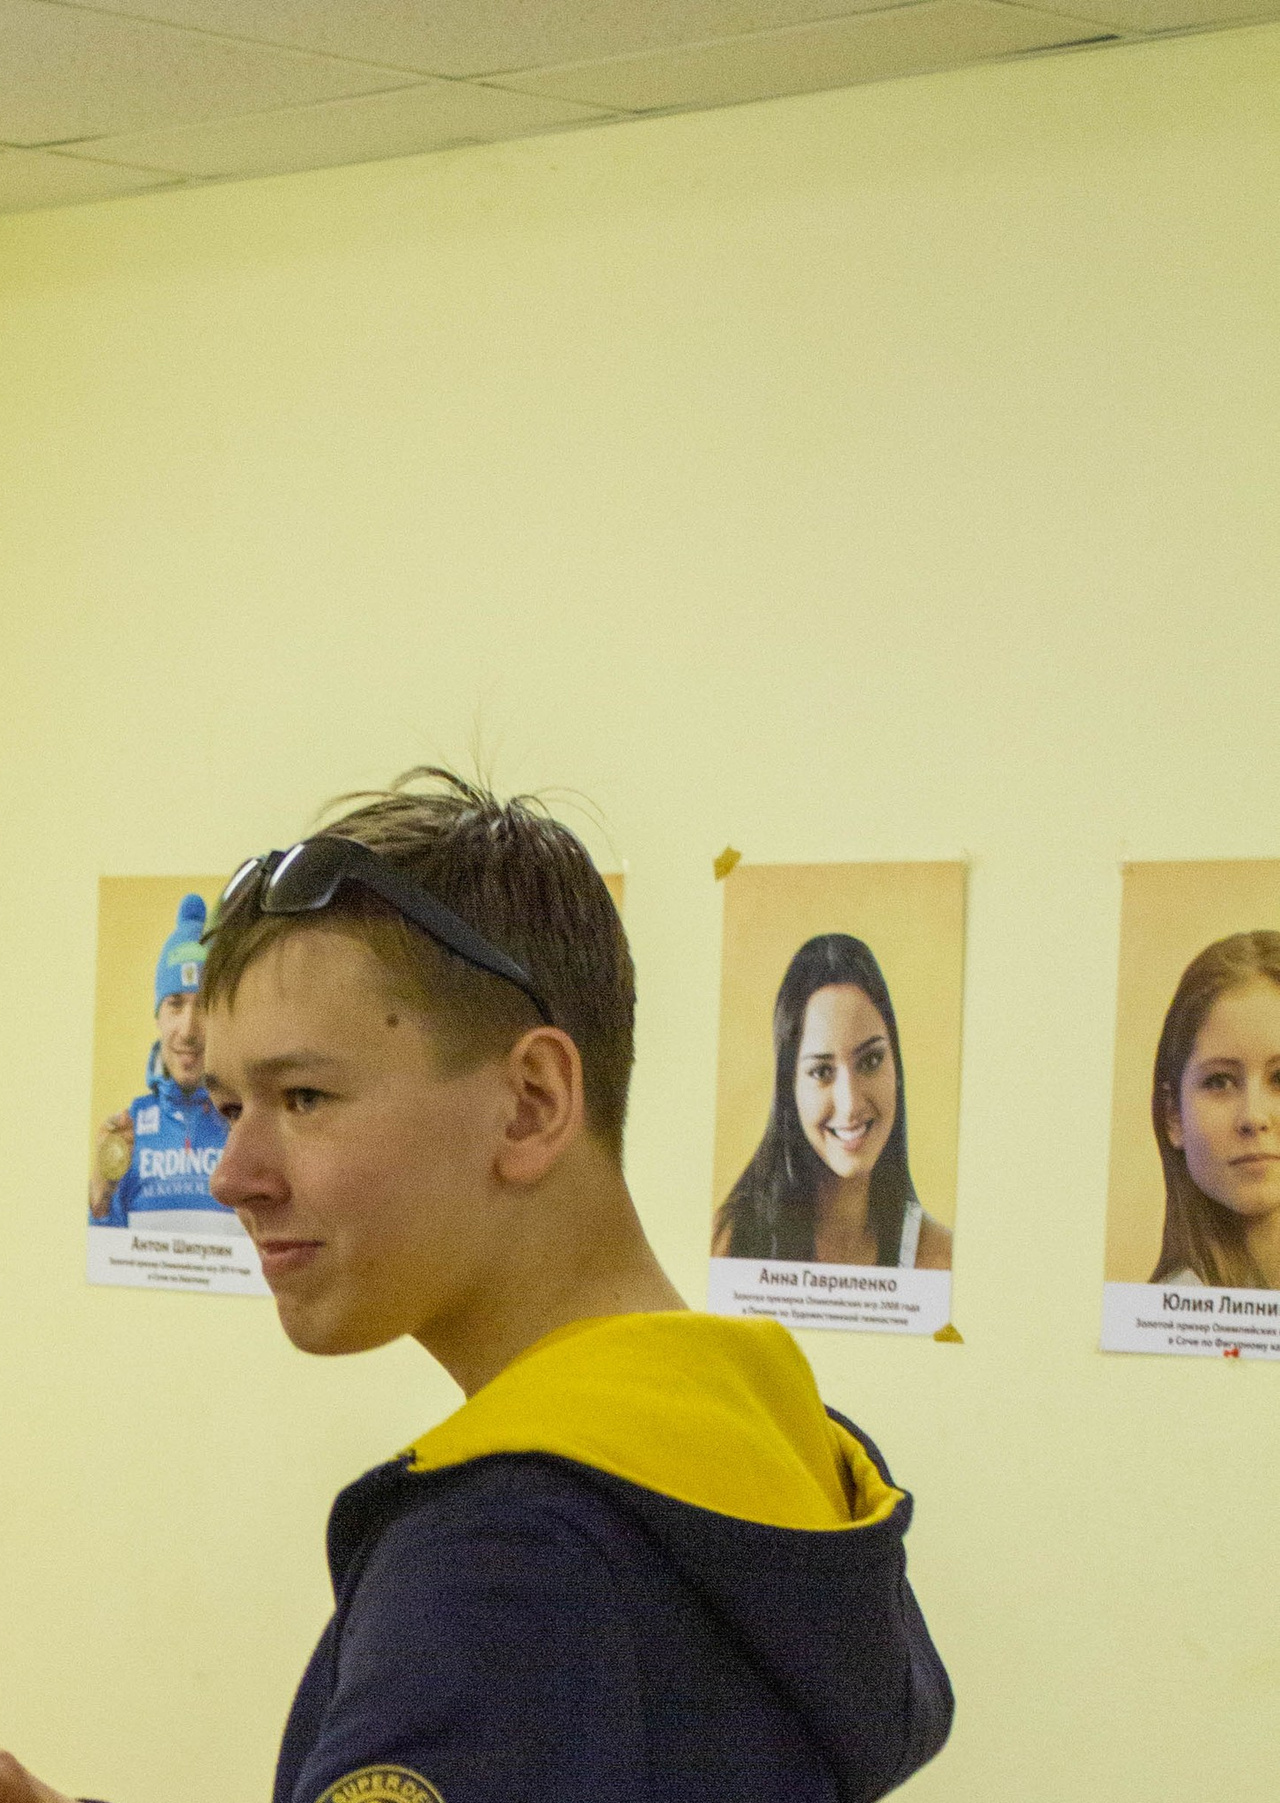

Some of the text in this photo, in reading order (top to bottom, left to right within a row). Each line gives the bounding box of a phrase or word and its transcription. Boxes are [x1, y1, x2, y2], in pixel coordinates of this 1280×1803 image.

[759, 1268, 897, 1292] Анна Гавриленко
[1162, 1292, 1278, 1317] Юлия Липни
